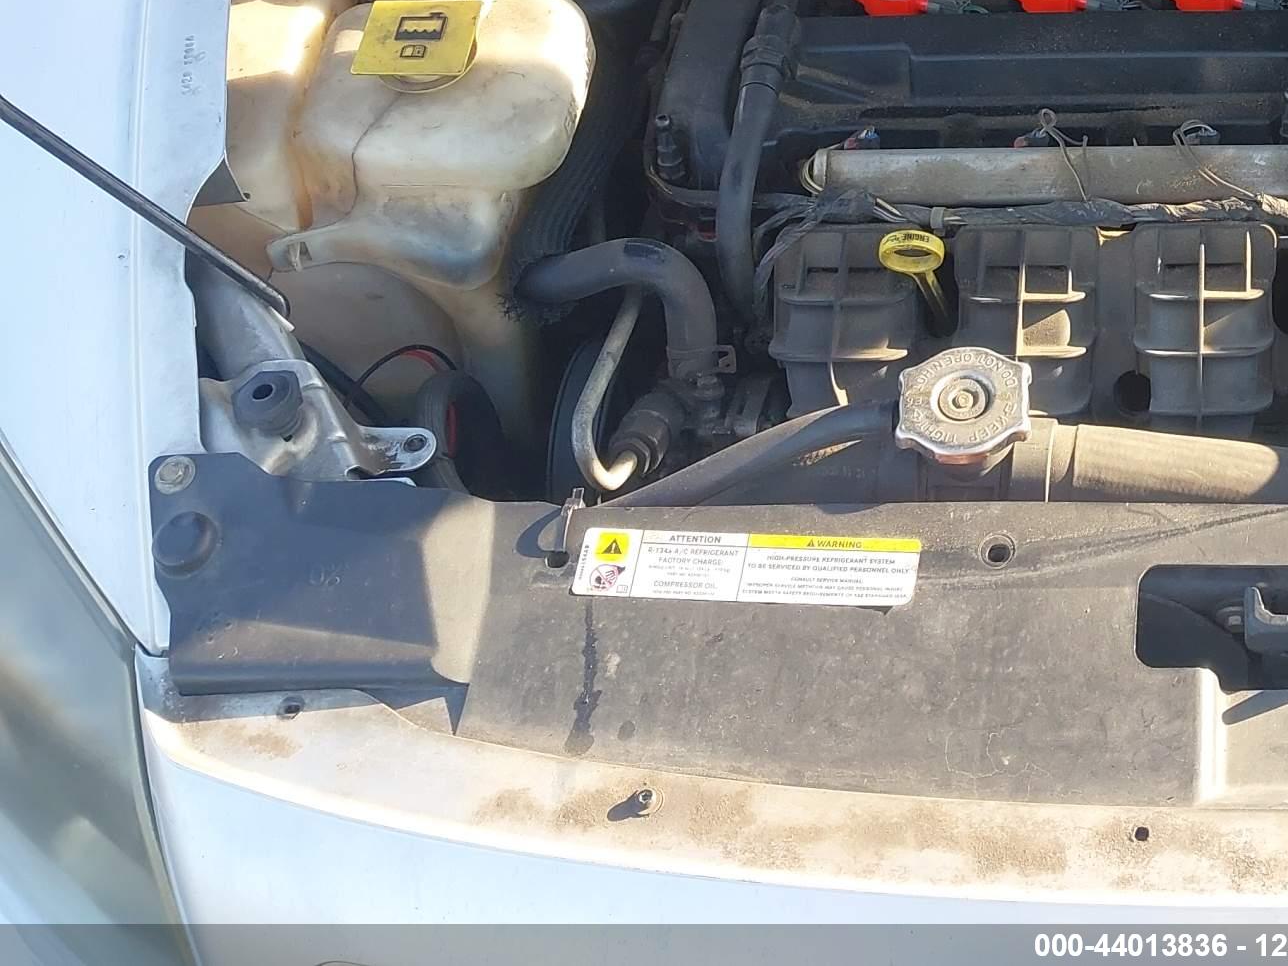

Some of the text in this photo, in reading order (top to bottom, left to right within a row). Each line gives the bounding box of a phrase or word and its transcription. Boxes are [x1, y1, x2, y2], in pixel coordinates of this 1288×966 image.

[901, 233, 930, 243] ENGINE
[968, 415, 1009, 443] KEEP
[669, 535, 722, 544] ATTENTION
[817, 540, 863, 549] WARNING
[690, 549, 740, 557] REFRIGERANT
[658, 557, 690, 565] FACTORY
[822, 556, 868, 564] REFRIGERANT
[768, 563, 801, 571] SERVICED
[812, 565, 848, 573] QUALIFIED
[849, 566, 890, 574] PERSONNEL
[653, 580, 704, 589] COMPRESSOR
